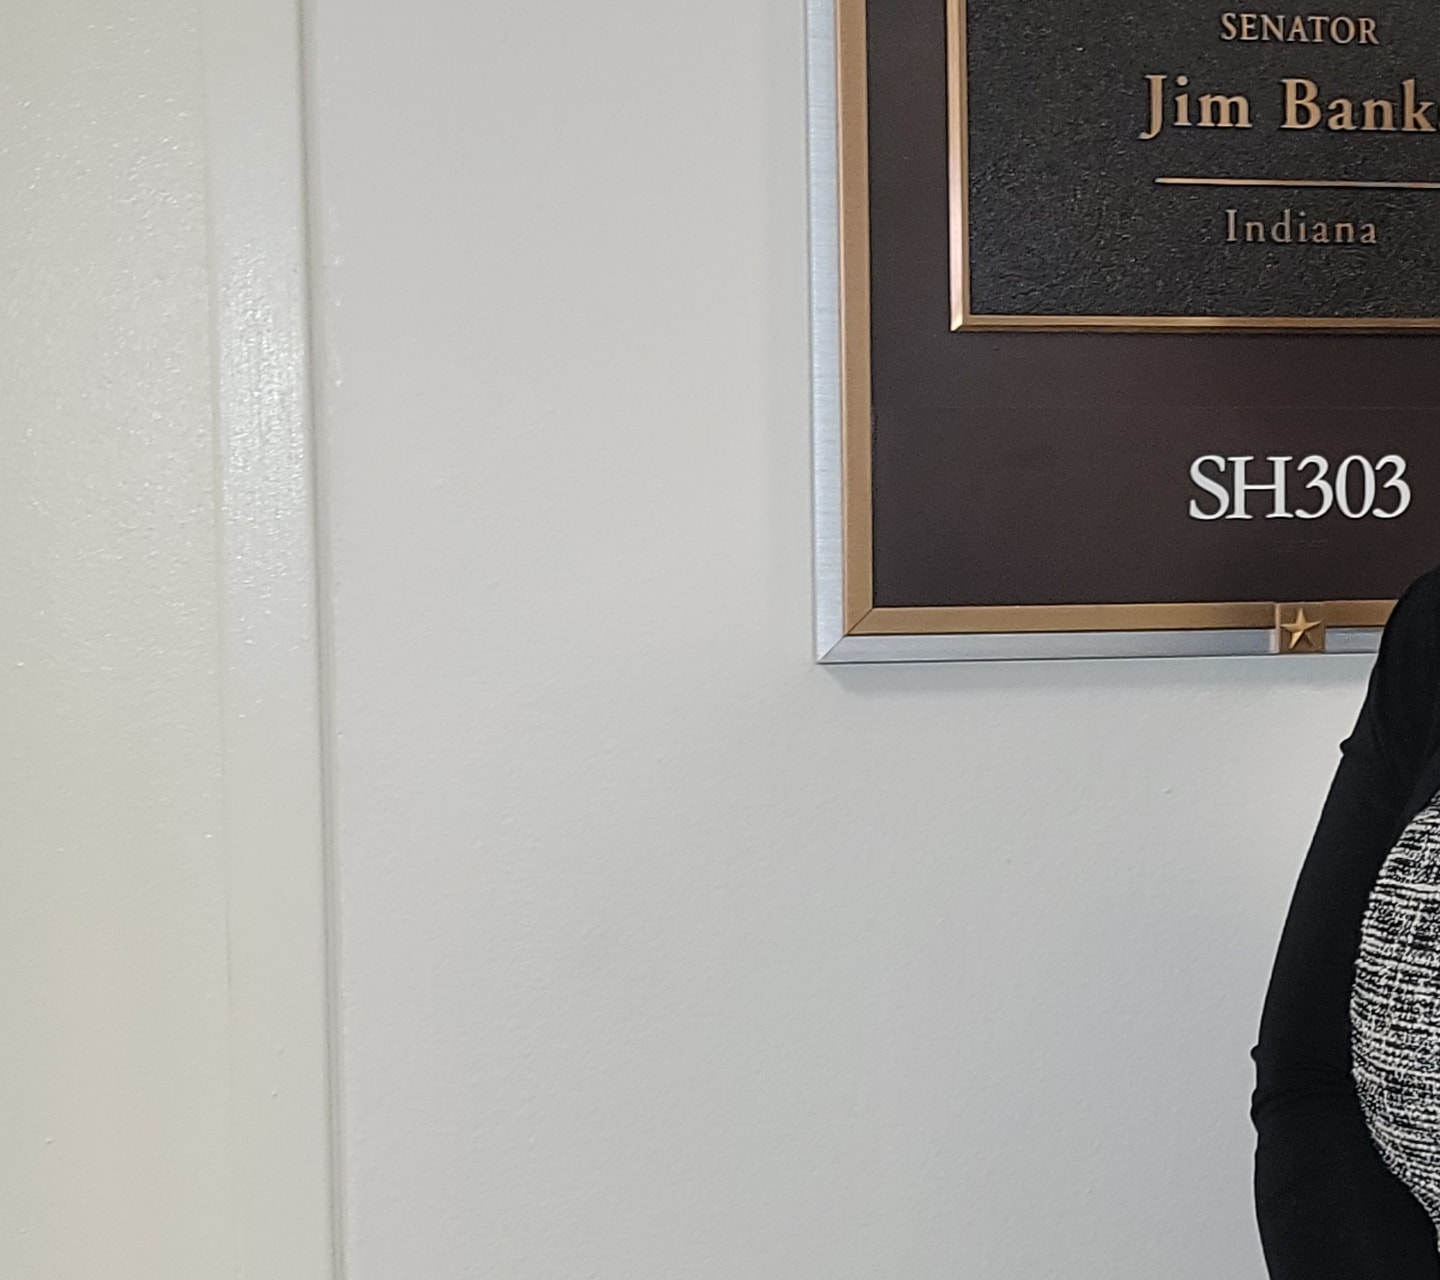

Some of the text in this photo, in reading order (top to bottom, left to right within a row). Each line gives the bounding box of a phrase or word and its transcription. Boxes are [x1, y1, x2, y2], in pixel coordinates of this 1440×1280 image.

[1220, 12, 1380, 45] SENATOR
[1139, 74, 1253, 141] Jim
[1225, 209, 1378, 246] Indiana
[1188, 454, 1412, 520] SH303
